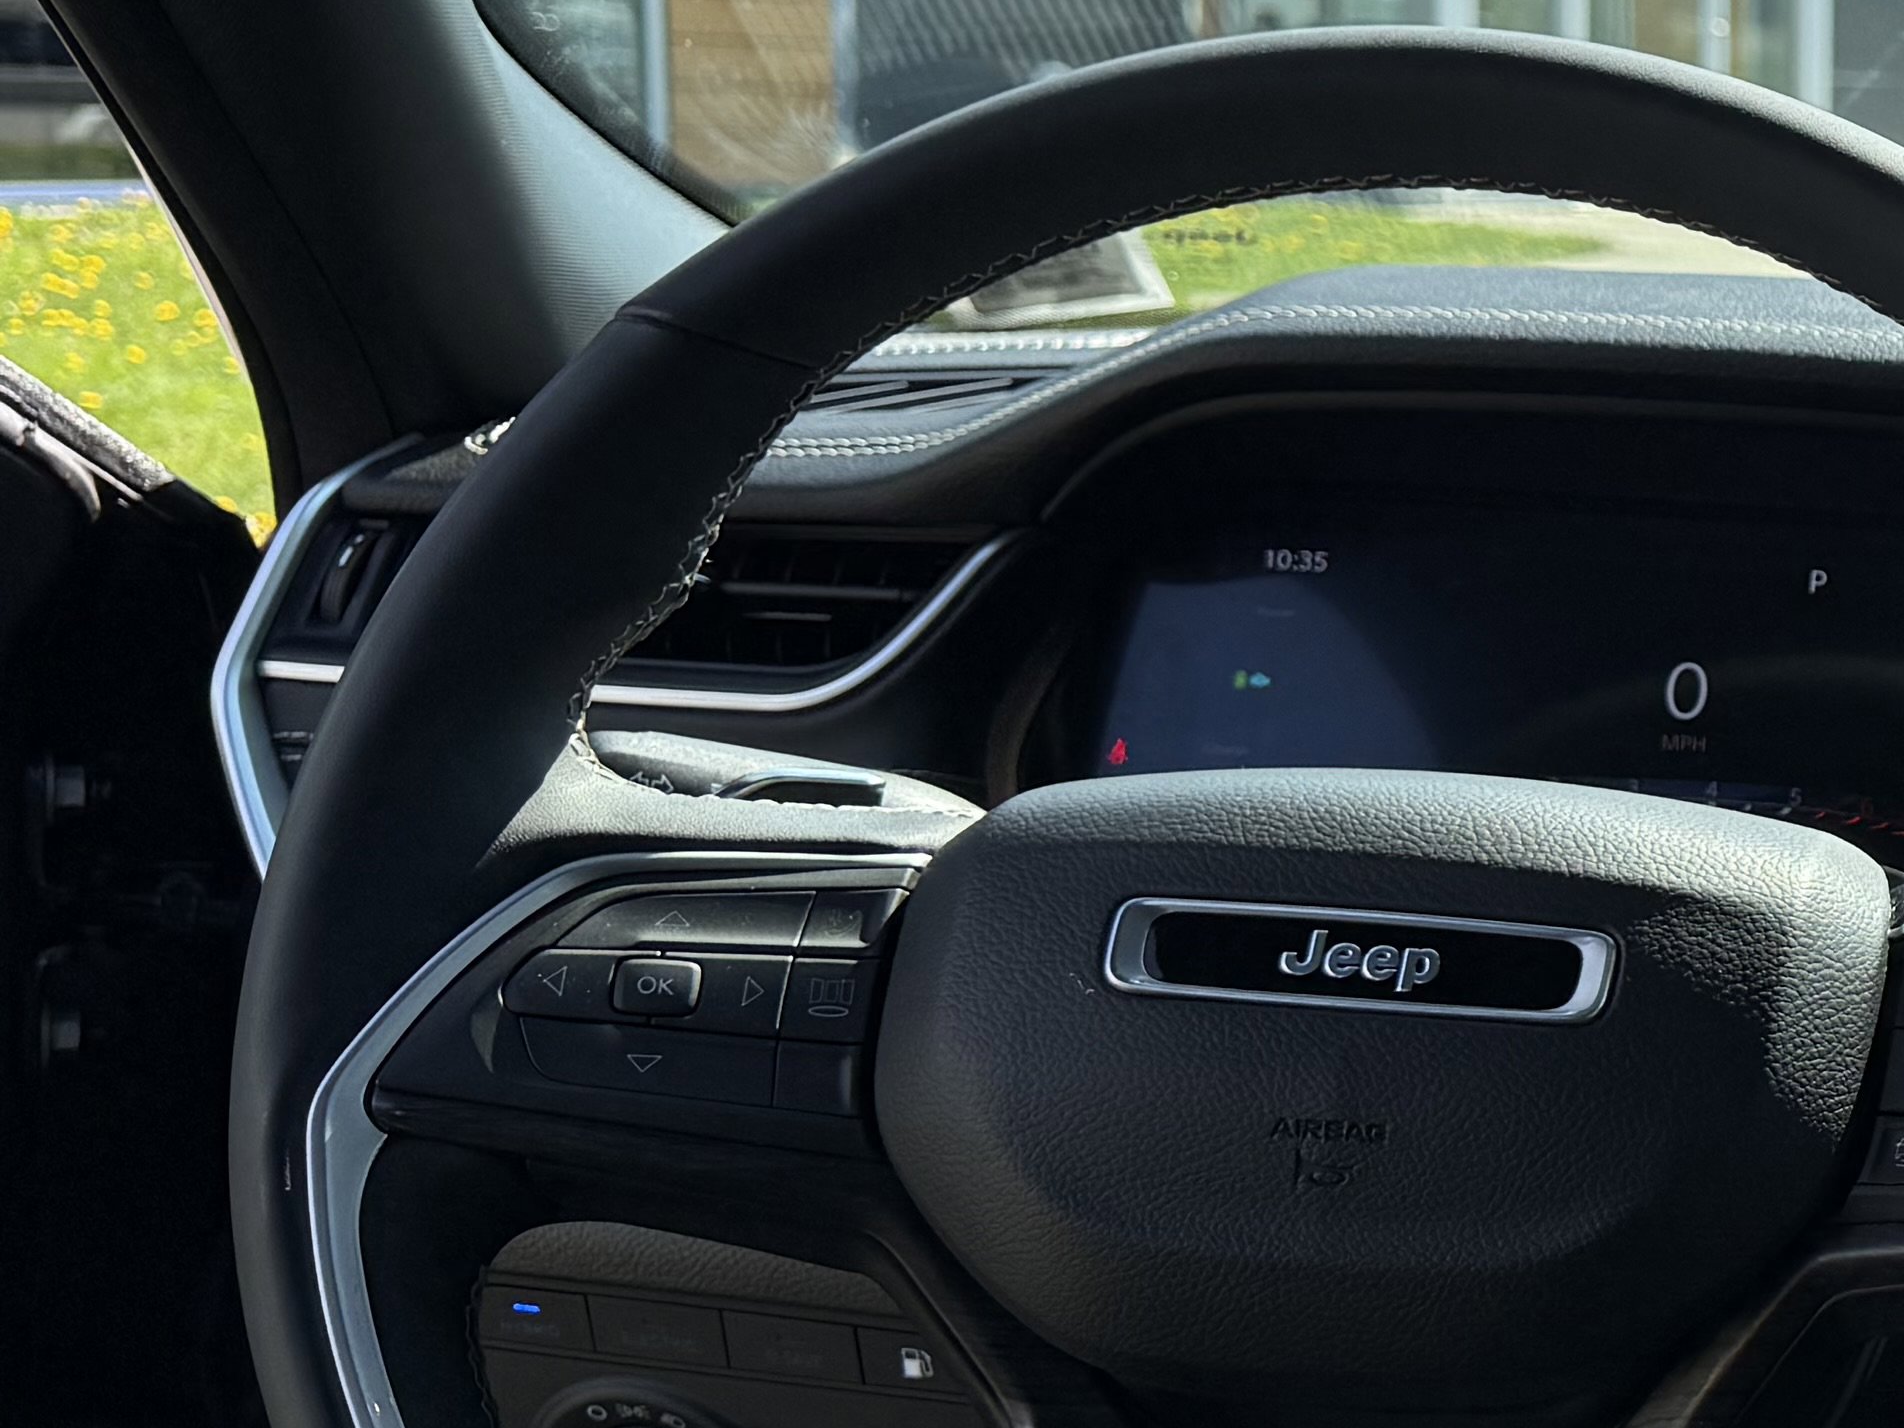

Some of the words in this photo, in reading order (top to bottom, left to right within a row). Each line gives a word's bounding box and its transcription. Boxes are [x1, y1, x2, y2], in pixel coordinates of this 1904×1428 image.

[1265, 548, 1328, 573] 10:35
[1808, 568, 1829, 595] P
[1665, 661, 1709, 721] 0
[1661, 733, 1707, 753] MPH
[1279, 929, 1441, 992] Jeep
[637, 975, 675, 996] OK
